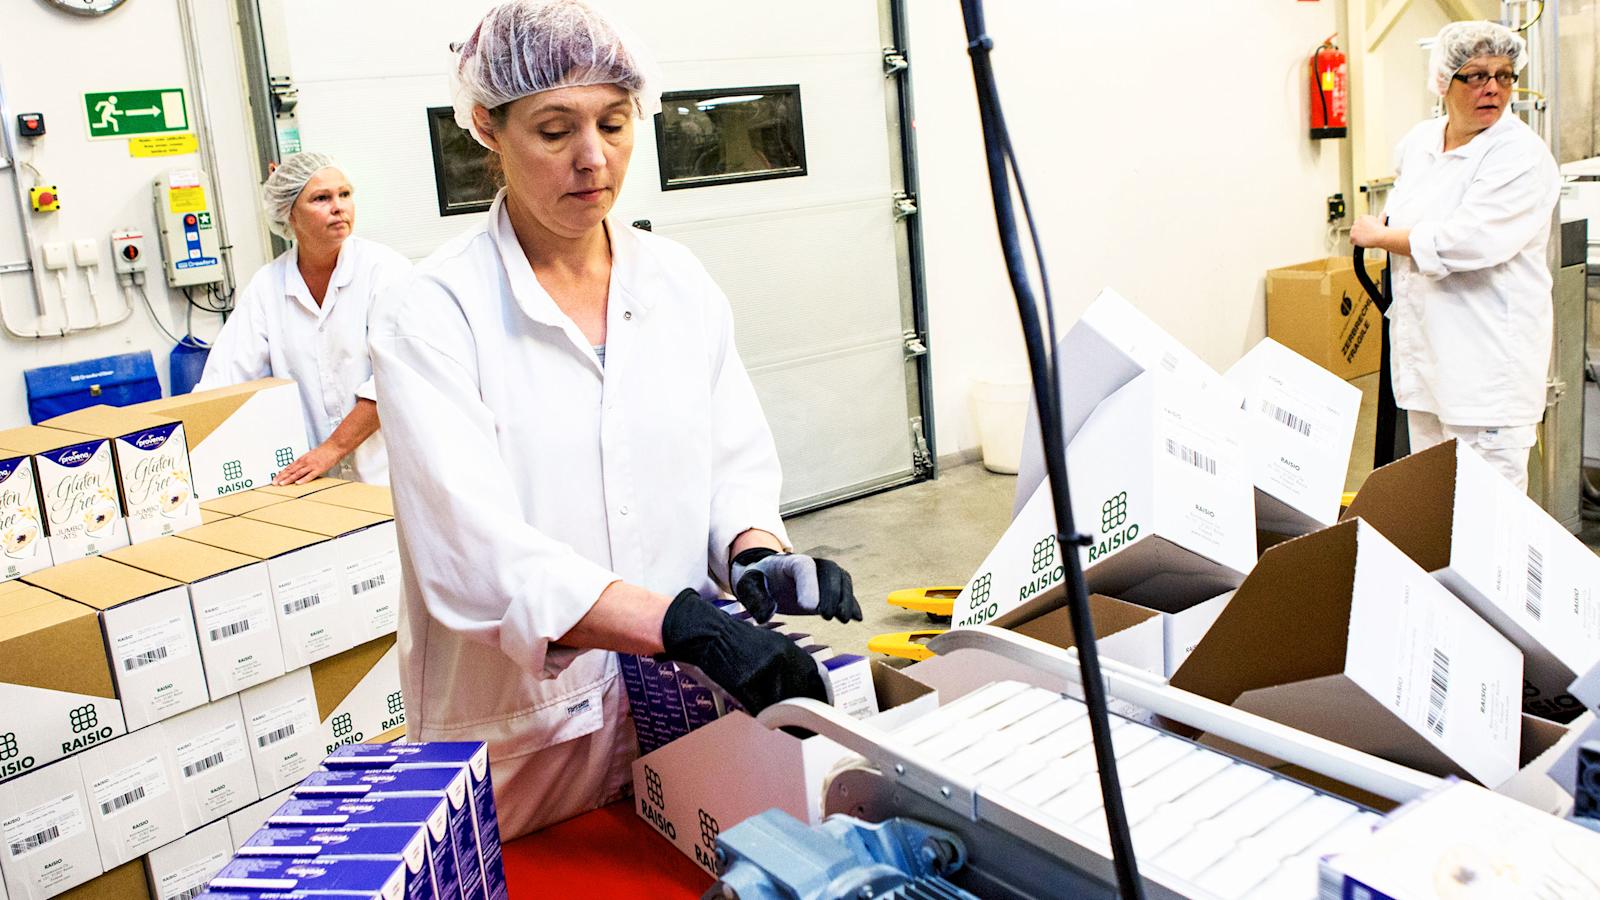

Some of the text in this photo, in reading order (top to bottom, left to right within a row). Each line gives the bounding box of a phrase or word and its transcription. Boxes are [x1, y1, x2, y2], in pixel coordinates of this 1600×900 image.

[1347, 320, 1370, 364] FRAGILE
[1280, 455, 1301, 472] RAISIO
[217, 479, 253, 495] RAISIO
[1195, 504, 1215, 518] RAISIO
[1088, 524, 1139, 564] RAISIO
[1019, 565, 1065, 601] RAISIO
[310, 629, 324, 637] RAISIO
[238, 655, 253, 664] RAISIO
[157, 683, 173, 693] RAISIO
[381, 713, 405, 730] RAIS
[62, 726, 113, 754] RAISIO
[284, 752, 298, 760] RAISIO
[0, 756, 35, 778] ISIO
[210, 784, 225, 794] RAISIO
[132, 820, 148, 830] RAISIO
[641, 799, 676, 840] RAISIO
[44, 858, 62, 869] RAISIO
[695, 843, 718, 876] RAI
